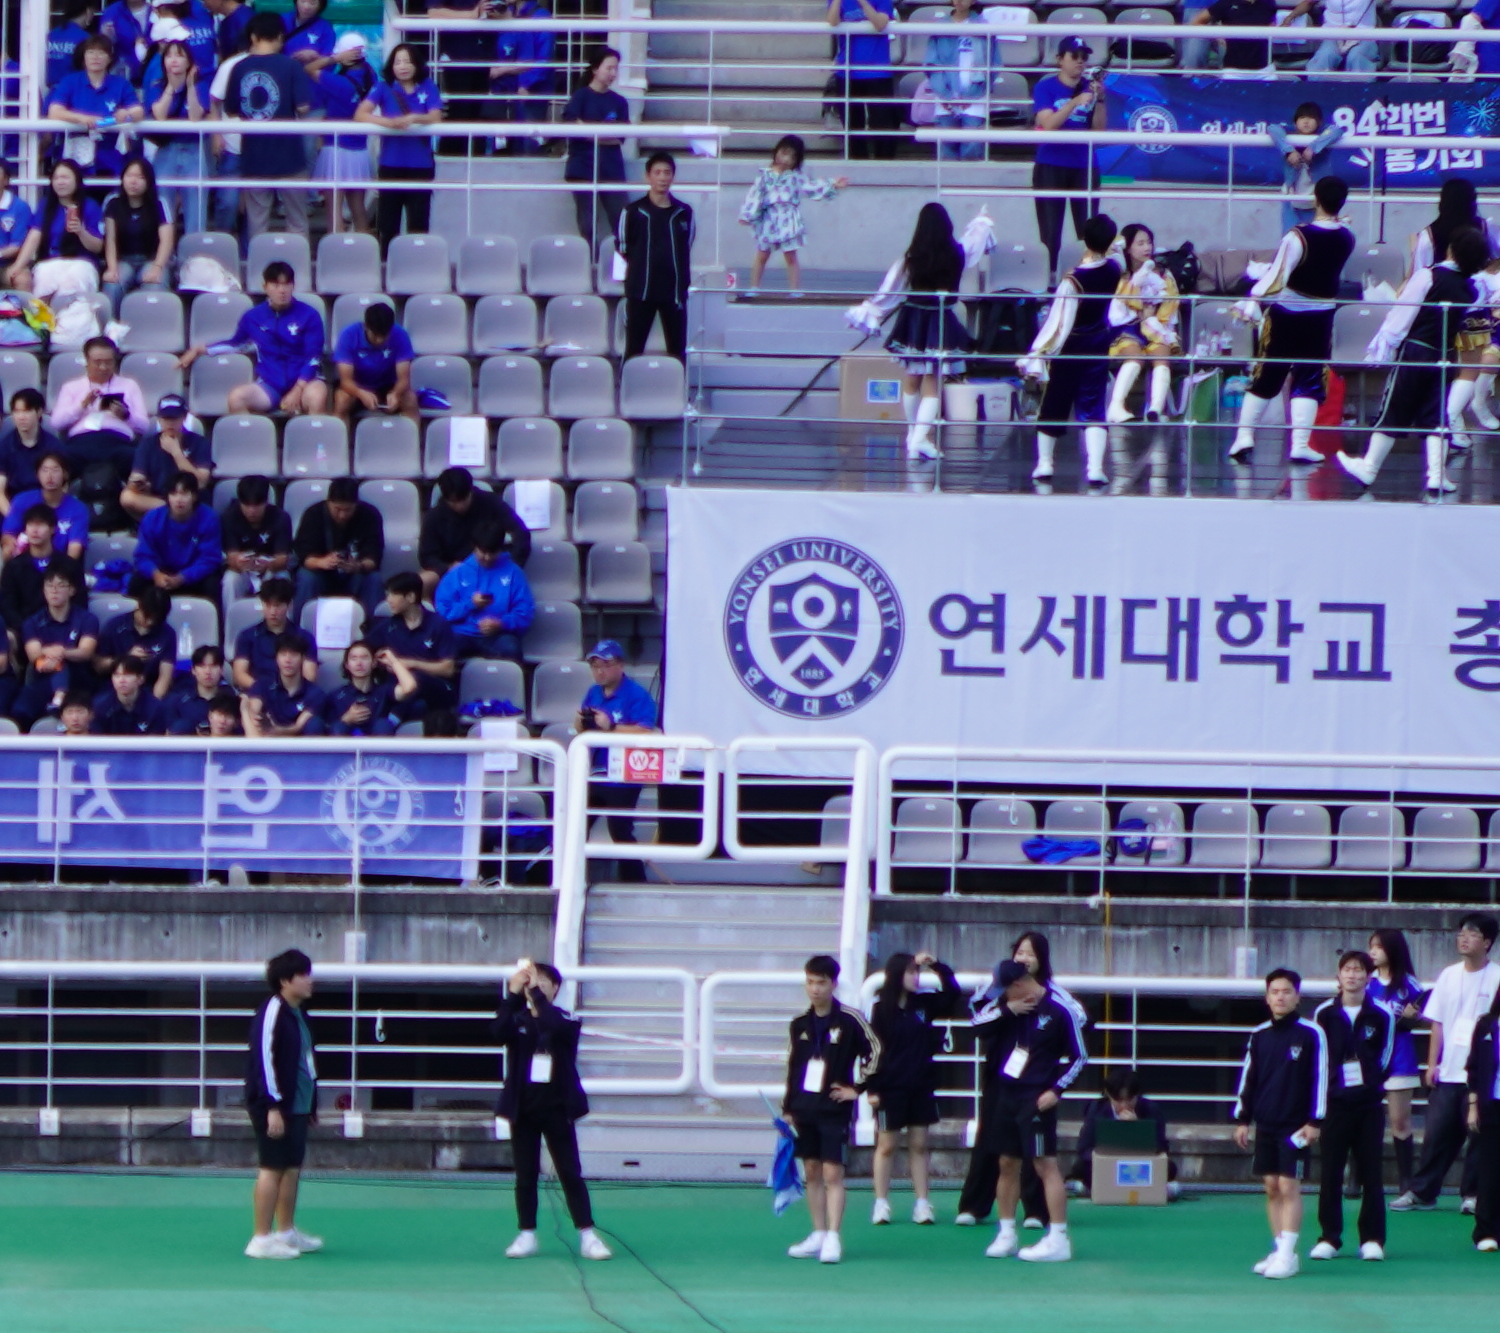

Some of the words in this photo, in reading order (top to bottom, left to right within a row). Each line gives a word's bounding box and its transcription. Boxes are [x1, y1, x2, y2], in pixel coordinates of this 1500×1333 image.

[729, 550, 786, 626] YONSEI
[791, 542, 900, 631] UNIVERSITY
[928, 593, 1393, 684] 연세대학교
[743, 665, 882, 716] 연세대학교
[629, 750, 660, 771] W2
